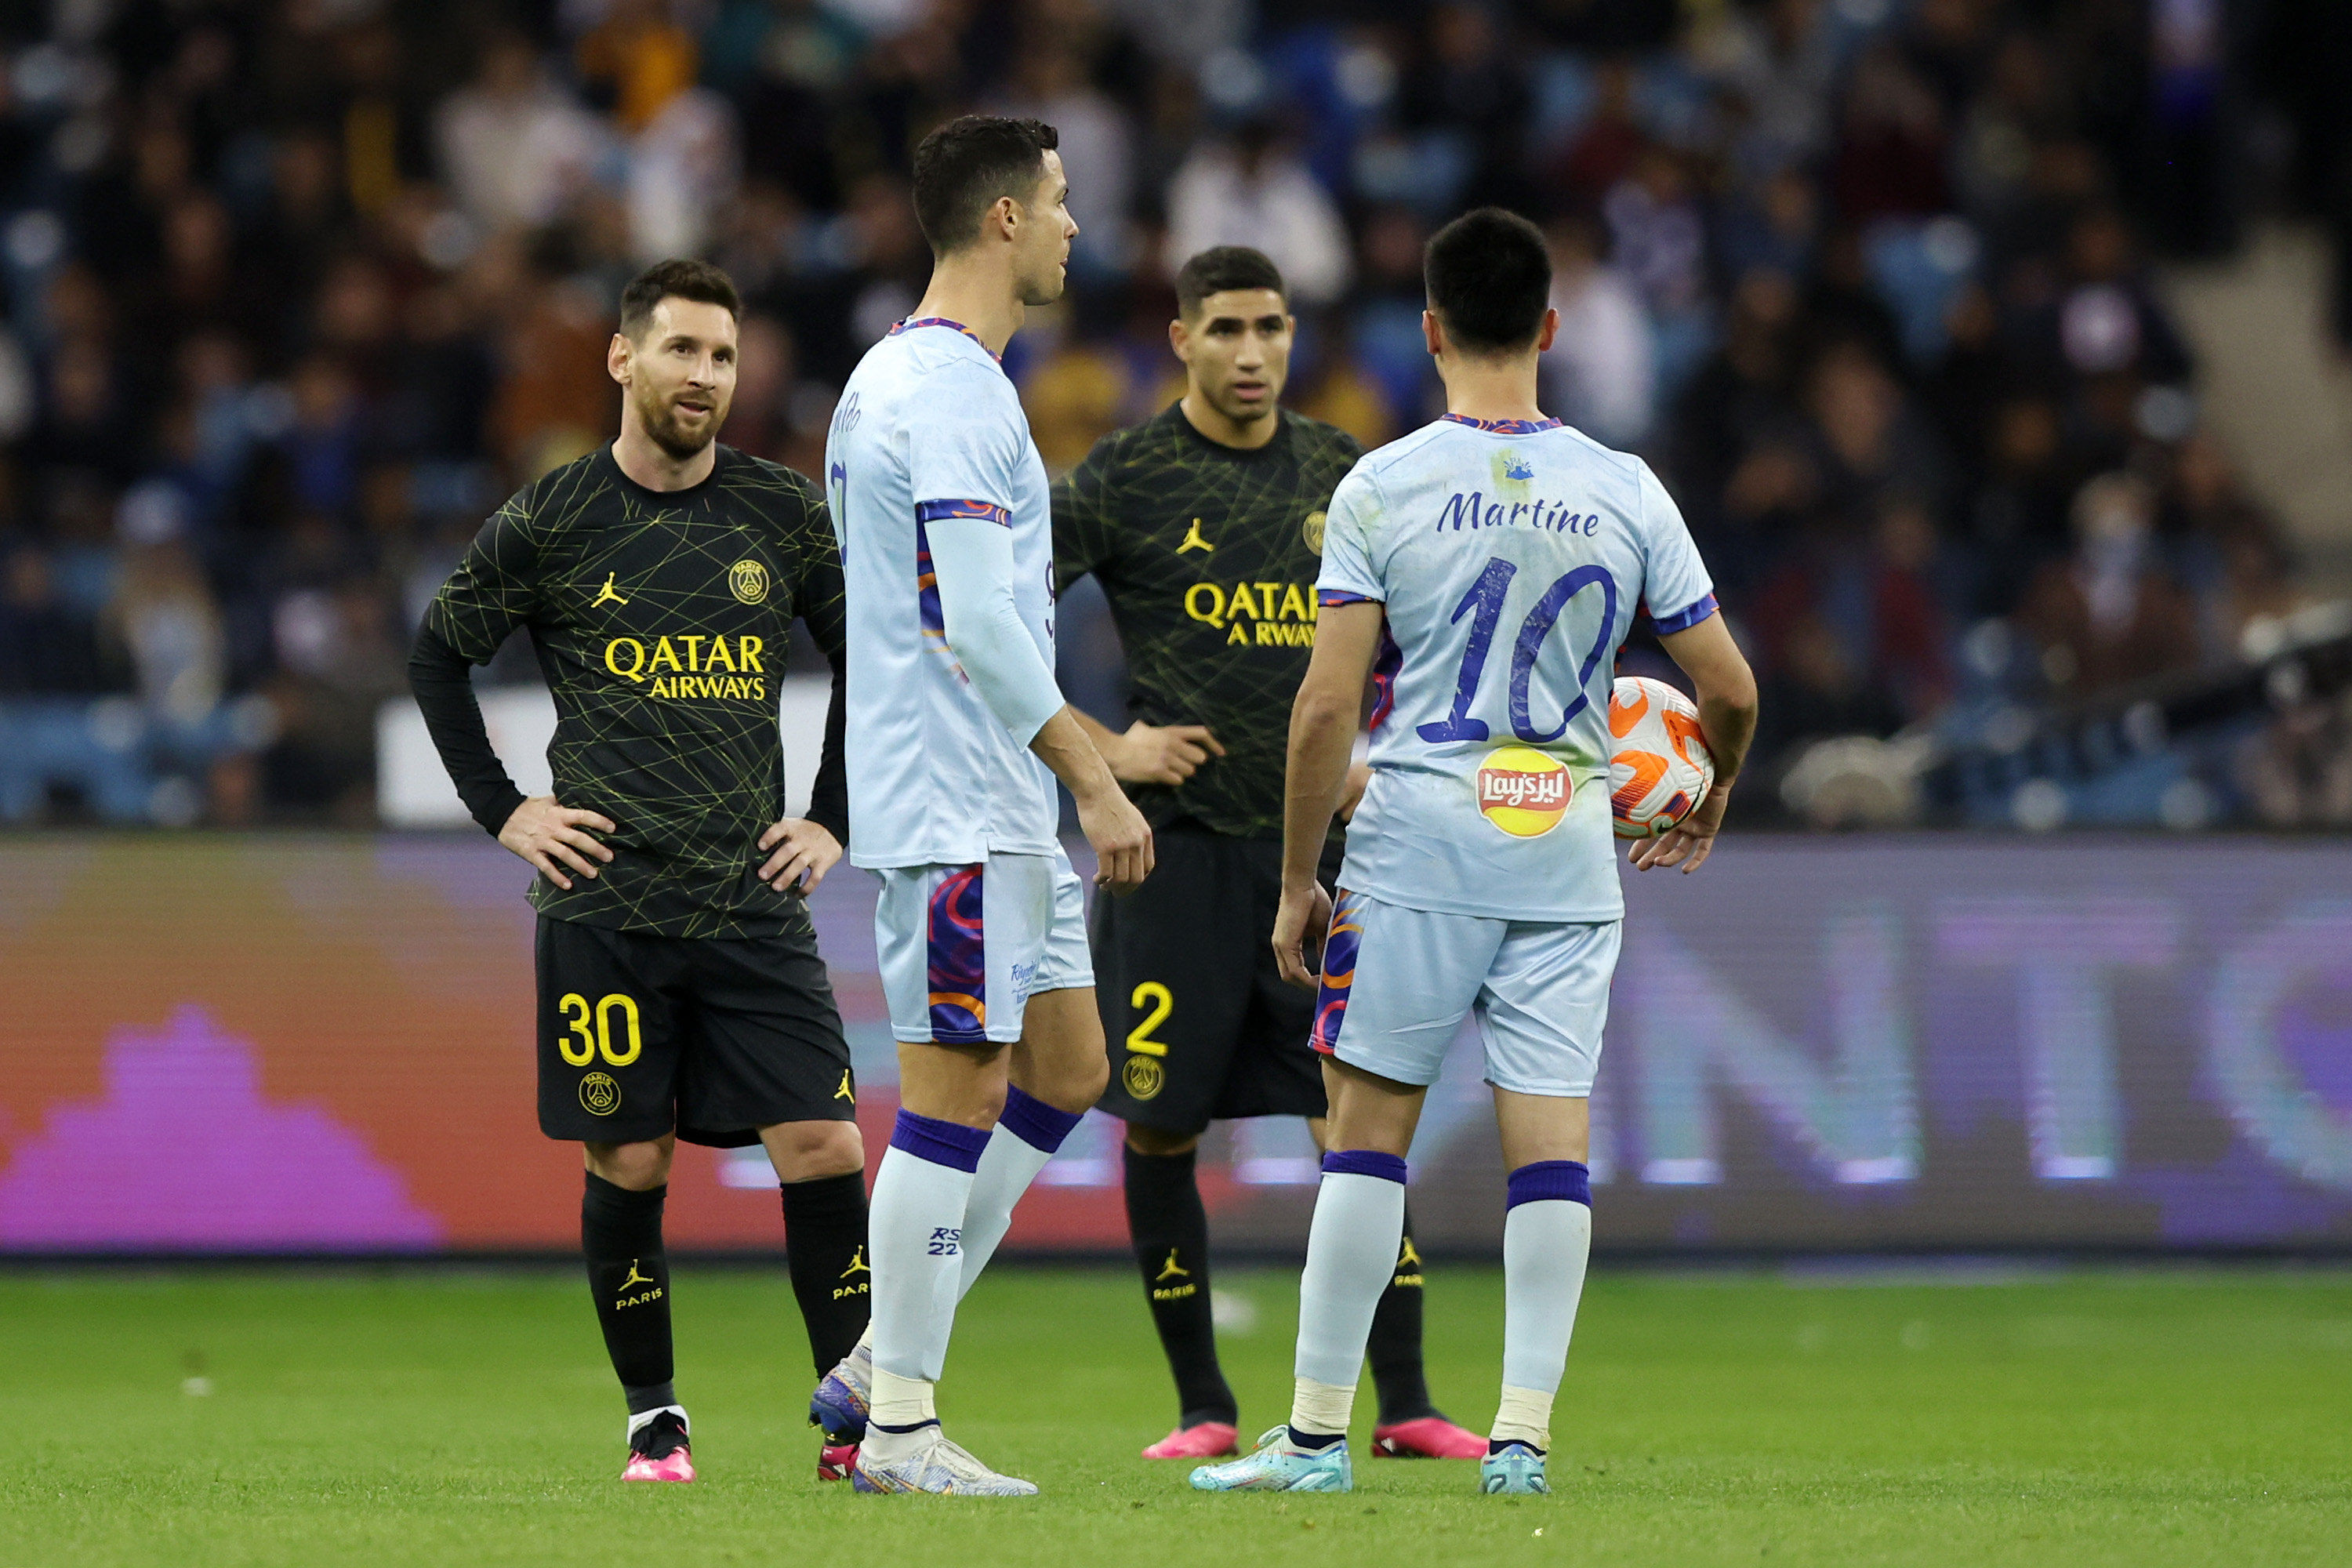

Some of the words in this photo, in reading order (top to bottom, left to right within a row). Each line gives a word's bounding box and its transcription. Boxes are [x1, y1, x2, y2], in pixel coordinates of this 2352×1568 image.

[735, 562, 762, 574] PARIS
[604, 636, 764, 683] QATAR
[1416, 557, 1617, 744] 10
[650, 677, 765, 700] AIRWAYS
[1483, 773, 1537, 806] Lay's
[558, 993, 642, 1067] 30
[1126, 981, 1174, 1057] 2
[930, 1228, 962, 1240] RS
[927, 1242, 958, 1255] 22
[616, 1287, 662, 1310] PARIS
[833, 1283, 868, 1300] PAR
